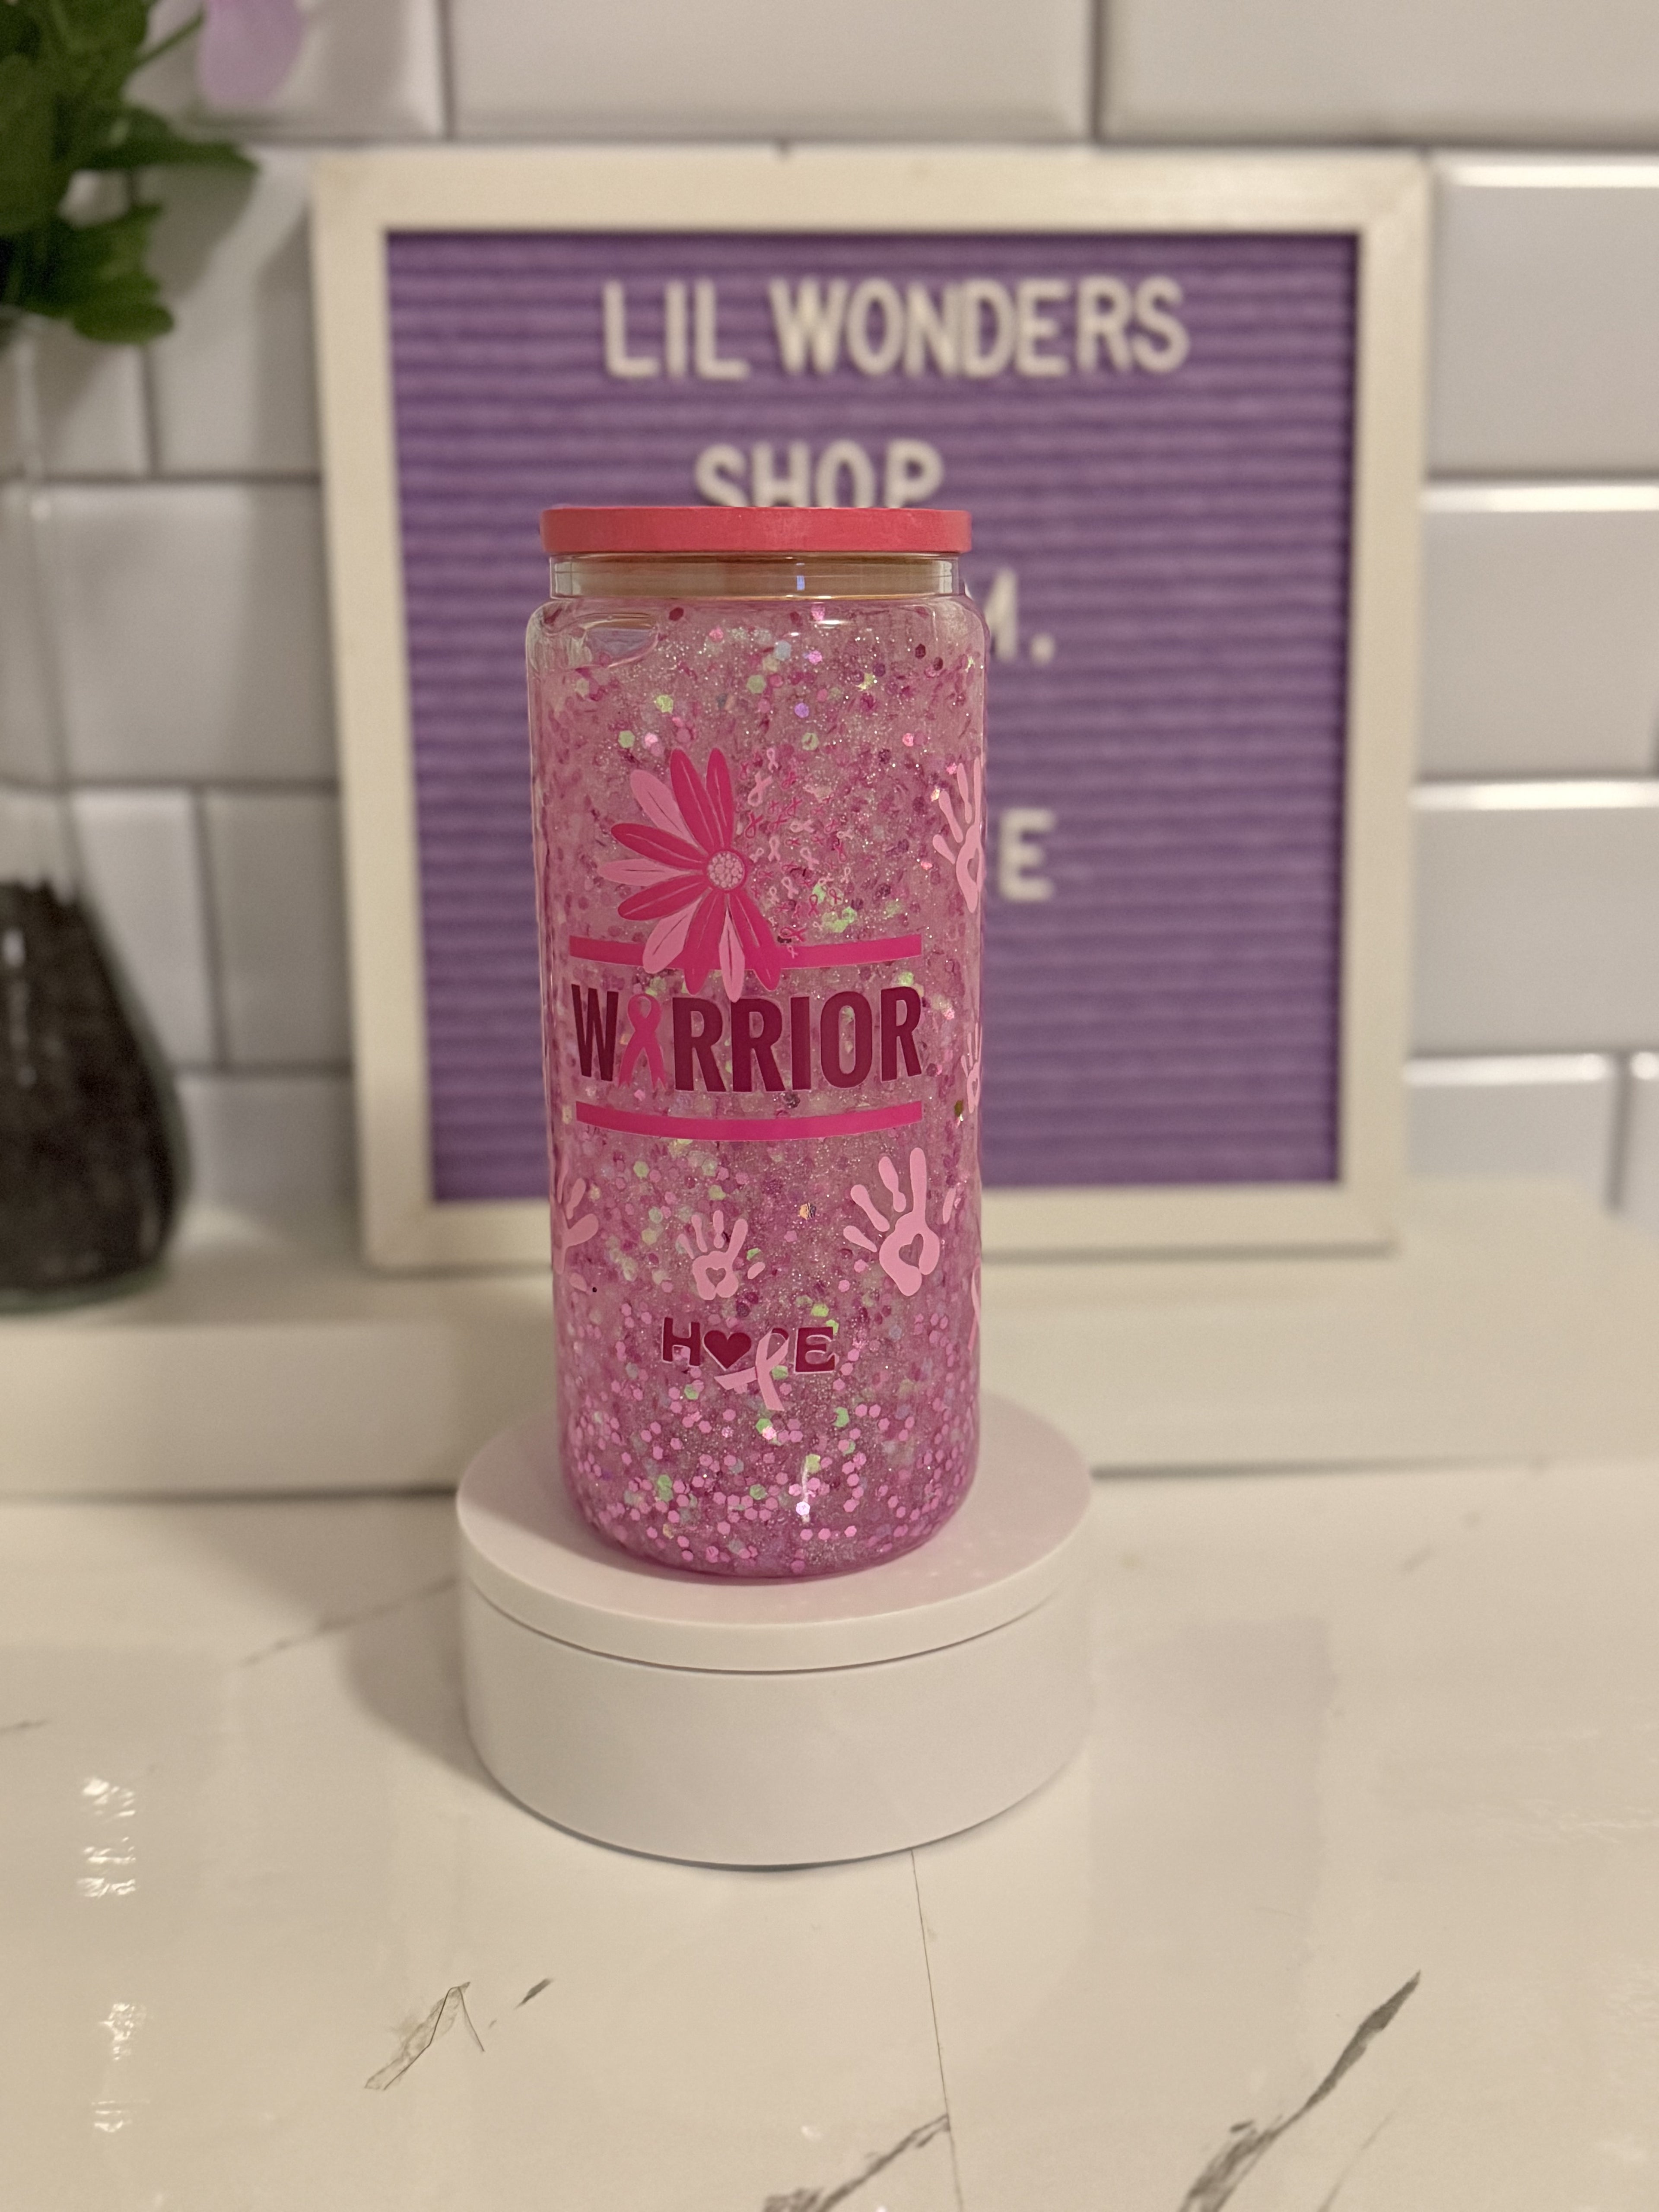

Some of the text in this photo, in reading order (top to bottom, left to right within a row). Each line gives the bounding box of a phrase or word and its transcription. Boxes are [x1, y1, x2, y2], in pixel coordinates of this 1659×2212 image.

[604, 276, 1192, 380] LIL WONDERS
[695, 439, 945, 507] SHOP
